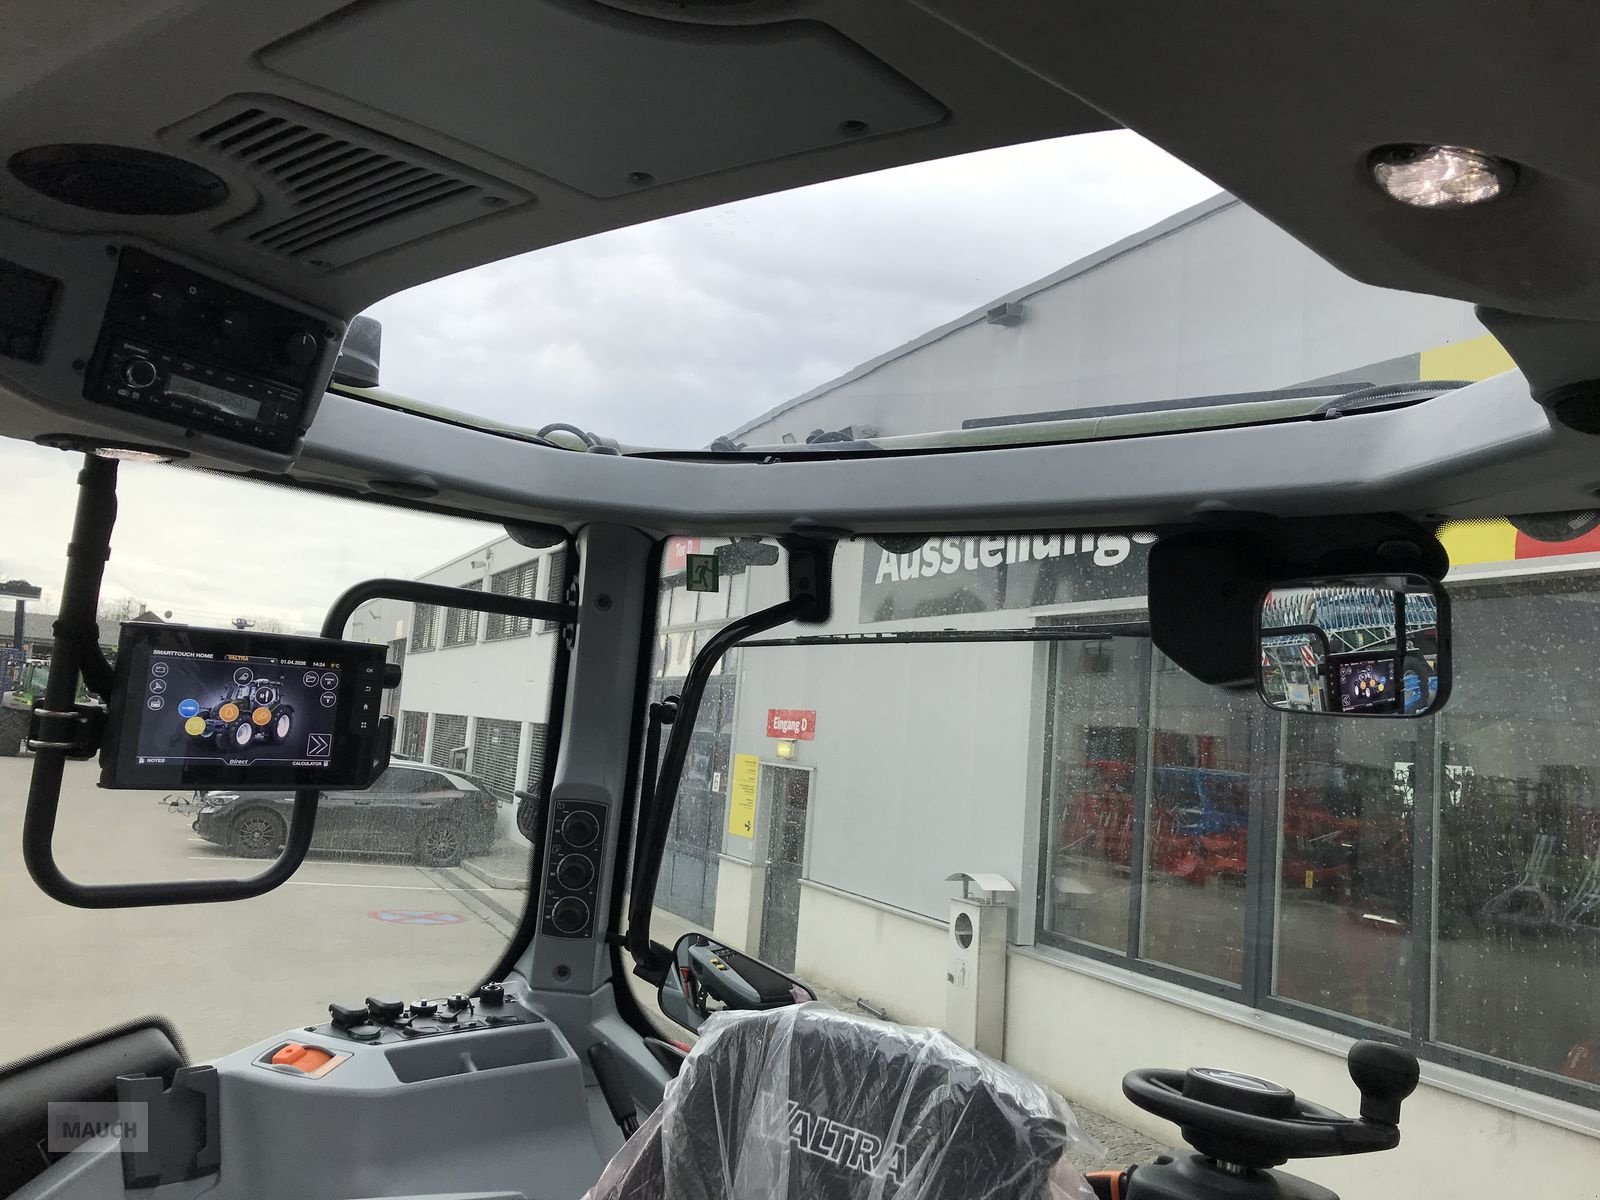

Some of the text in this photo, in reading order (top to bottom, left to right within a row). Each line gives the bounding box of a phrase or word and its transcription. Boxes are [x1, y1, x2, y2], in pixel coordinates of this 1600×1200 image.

[875, 534, 1157, 584] Ausstellung
[152, 649, 195, 658] SMARTTOUCH
[773, 716, 808, 734] Eingang D
[760, 1091, 907, 1185] VALTRA
